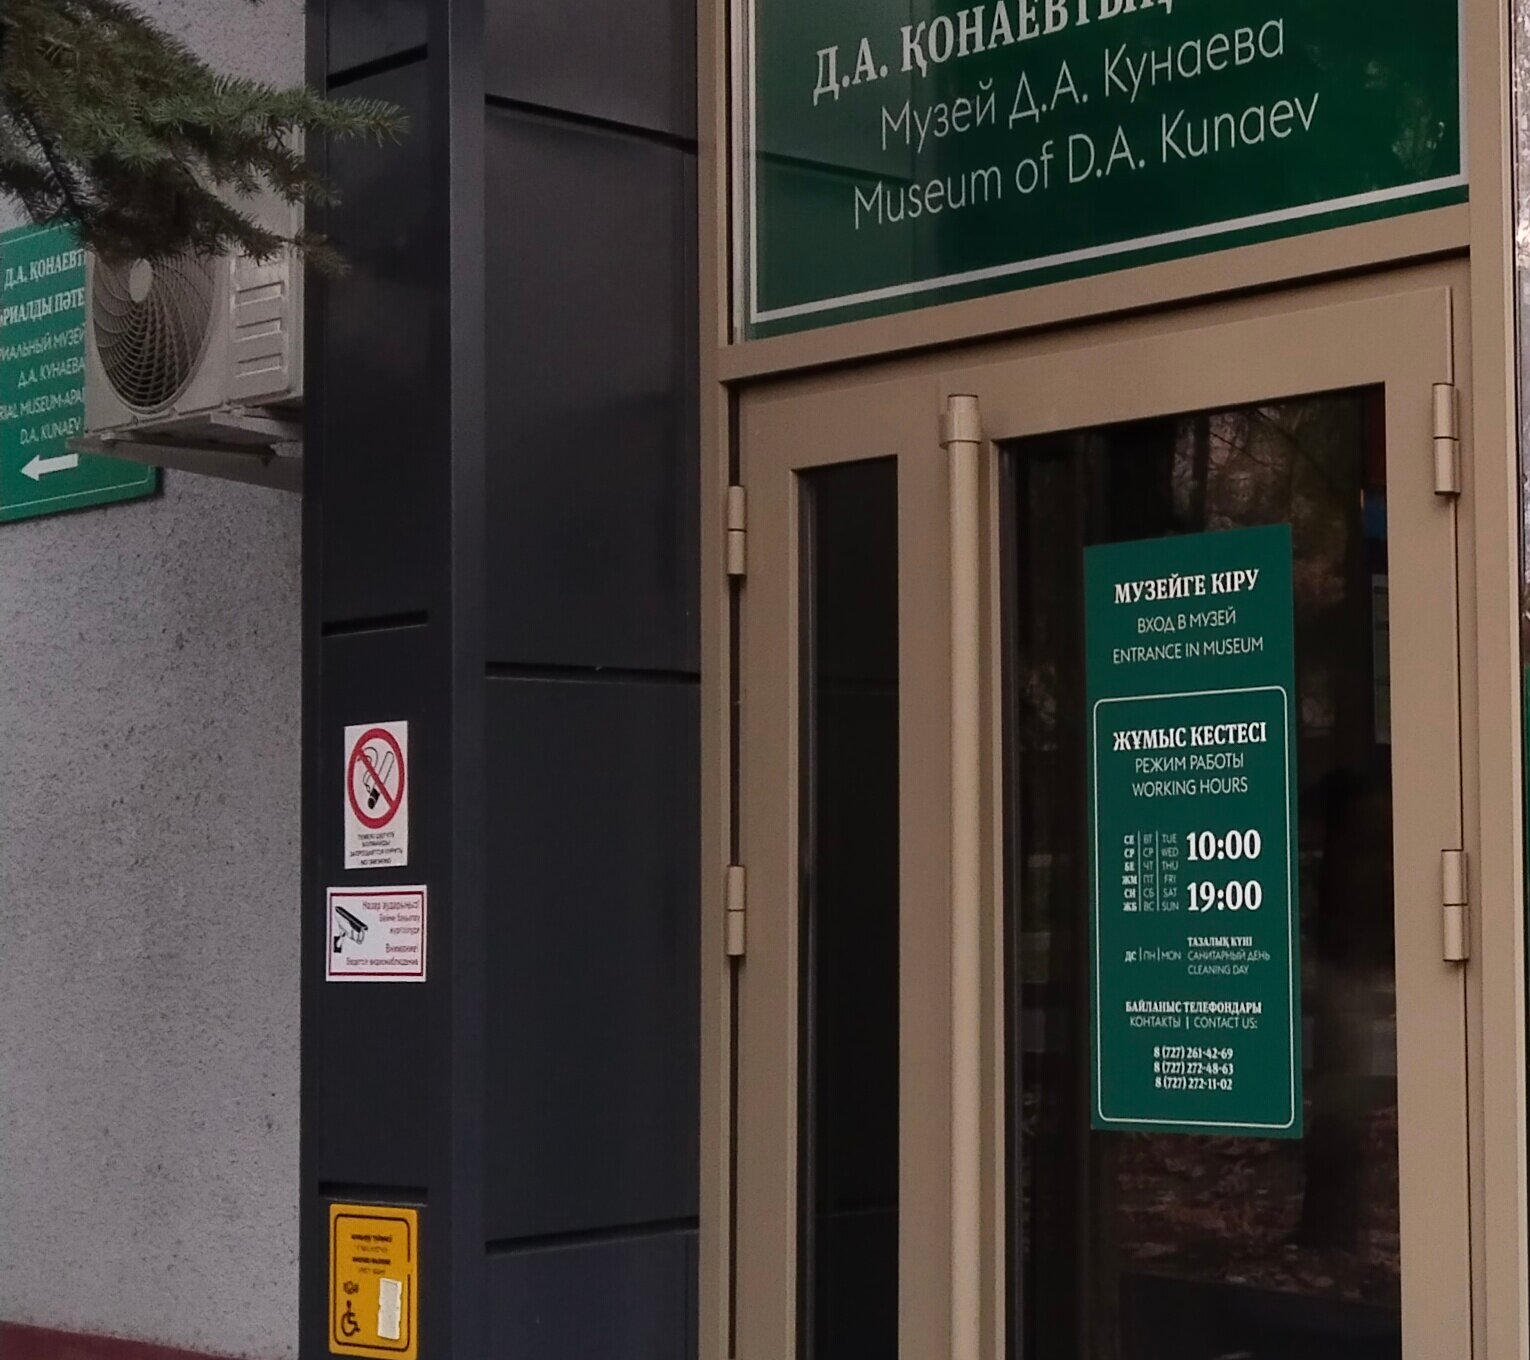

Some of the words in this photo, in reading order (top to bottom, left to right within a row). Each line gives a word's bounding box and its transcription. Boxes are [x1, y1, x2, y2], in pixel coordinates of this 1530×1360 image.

[812, 34, 889, 105] Д.А.
[881, 80, 997, 154] Музей
[1008, 60, 1089, 130] Д.А.
[1104, 18, 1284, 104] Кунаева
[854, 163, 1001, 230] Museum
[1015, 144, 1054, 193] of
[1068, 125, 1145, 185] D.A.
[1161, 92, 1319, 164] Kunaev
[30, 248, 87, 282] ҚОНАЕВТ
[1114, 573, 1206, 604] МУЗЕЙГЕ
[1211, 569, 1260, 595] КІРУ
[1137, 617, 1175, 634] ВХОД
[1178, 614, 1186, 630] В
[1190, 606, 1236, 628] МУЗЕЙ
[1113, 643, 1181, 664] ENTRANCE
[1185, 643, 1199, 658] IN
[1203, 637, 1263, 656] MUSEUM
[1113, 727, 1186, 751] ЖҰМЫС
[1190, 722, 1267, 747] КЕСТЕСІ
[1135, 756, 1186, 774] РЕЖИМ
[1190, 752, 1244, 770] РАБОТЫ
[1132, 779, 1196, 797] WORKING
[1200, 776, 1248, 795] HOURS
[1162, 833, 1177, 844] TUE
[1186, 829, 1261, 861] 10:00
[1161, 848, 1179, 858] WED
[1162, 861, 1179, 871] THU
[1164, 875, 1176, 885] FRI
[1163, 888, 1177, 898] SAT
[1187, 880, 1262, 912] 19:00
[1161, 901, 1179, 912] SUN
[1161, 950, 1181, 960] MON
[1187, 950, 1246, 961] САНИТАРНЫЙ
[1247, 950, 1271, 962] ДЕНЬ
[1188, 965, 1231, 975] CLEANING
[1232, 964, 1249, 975] DAY
[1125, 1000, 1182, 1013] БАЙЛАНЫС
[1183, 1001, 1262, 1015] ТЕЛЕФОНДАРЫ
[1130, 1016, 1181, 1027] КОНТАКТЫ
[1194, 1017, 1239, 1029] CONTACT
[1153, 1046, 1160, 1058] 8
[1162, 1045, 1185, 1059] (727)
[1186, 1046, 1233, 1060] 261-42-69
[1153, 1061, 1160, 1074] 8
[1162, 1060, 1185, 1075] (727)
[1186, 1061, 1233, 1076] 272-48-63
[1154, 1077, 1161, 1089] 8
[1163, 1076, 1186, 1090] (727)
[1187, 1077, 1233, 1090] 272-11-02
